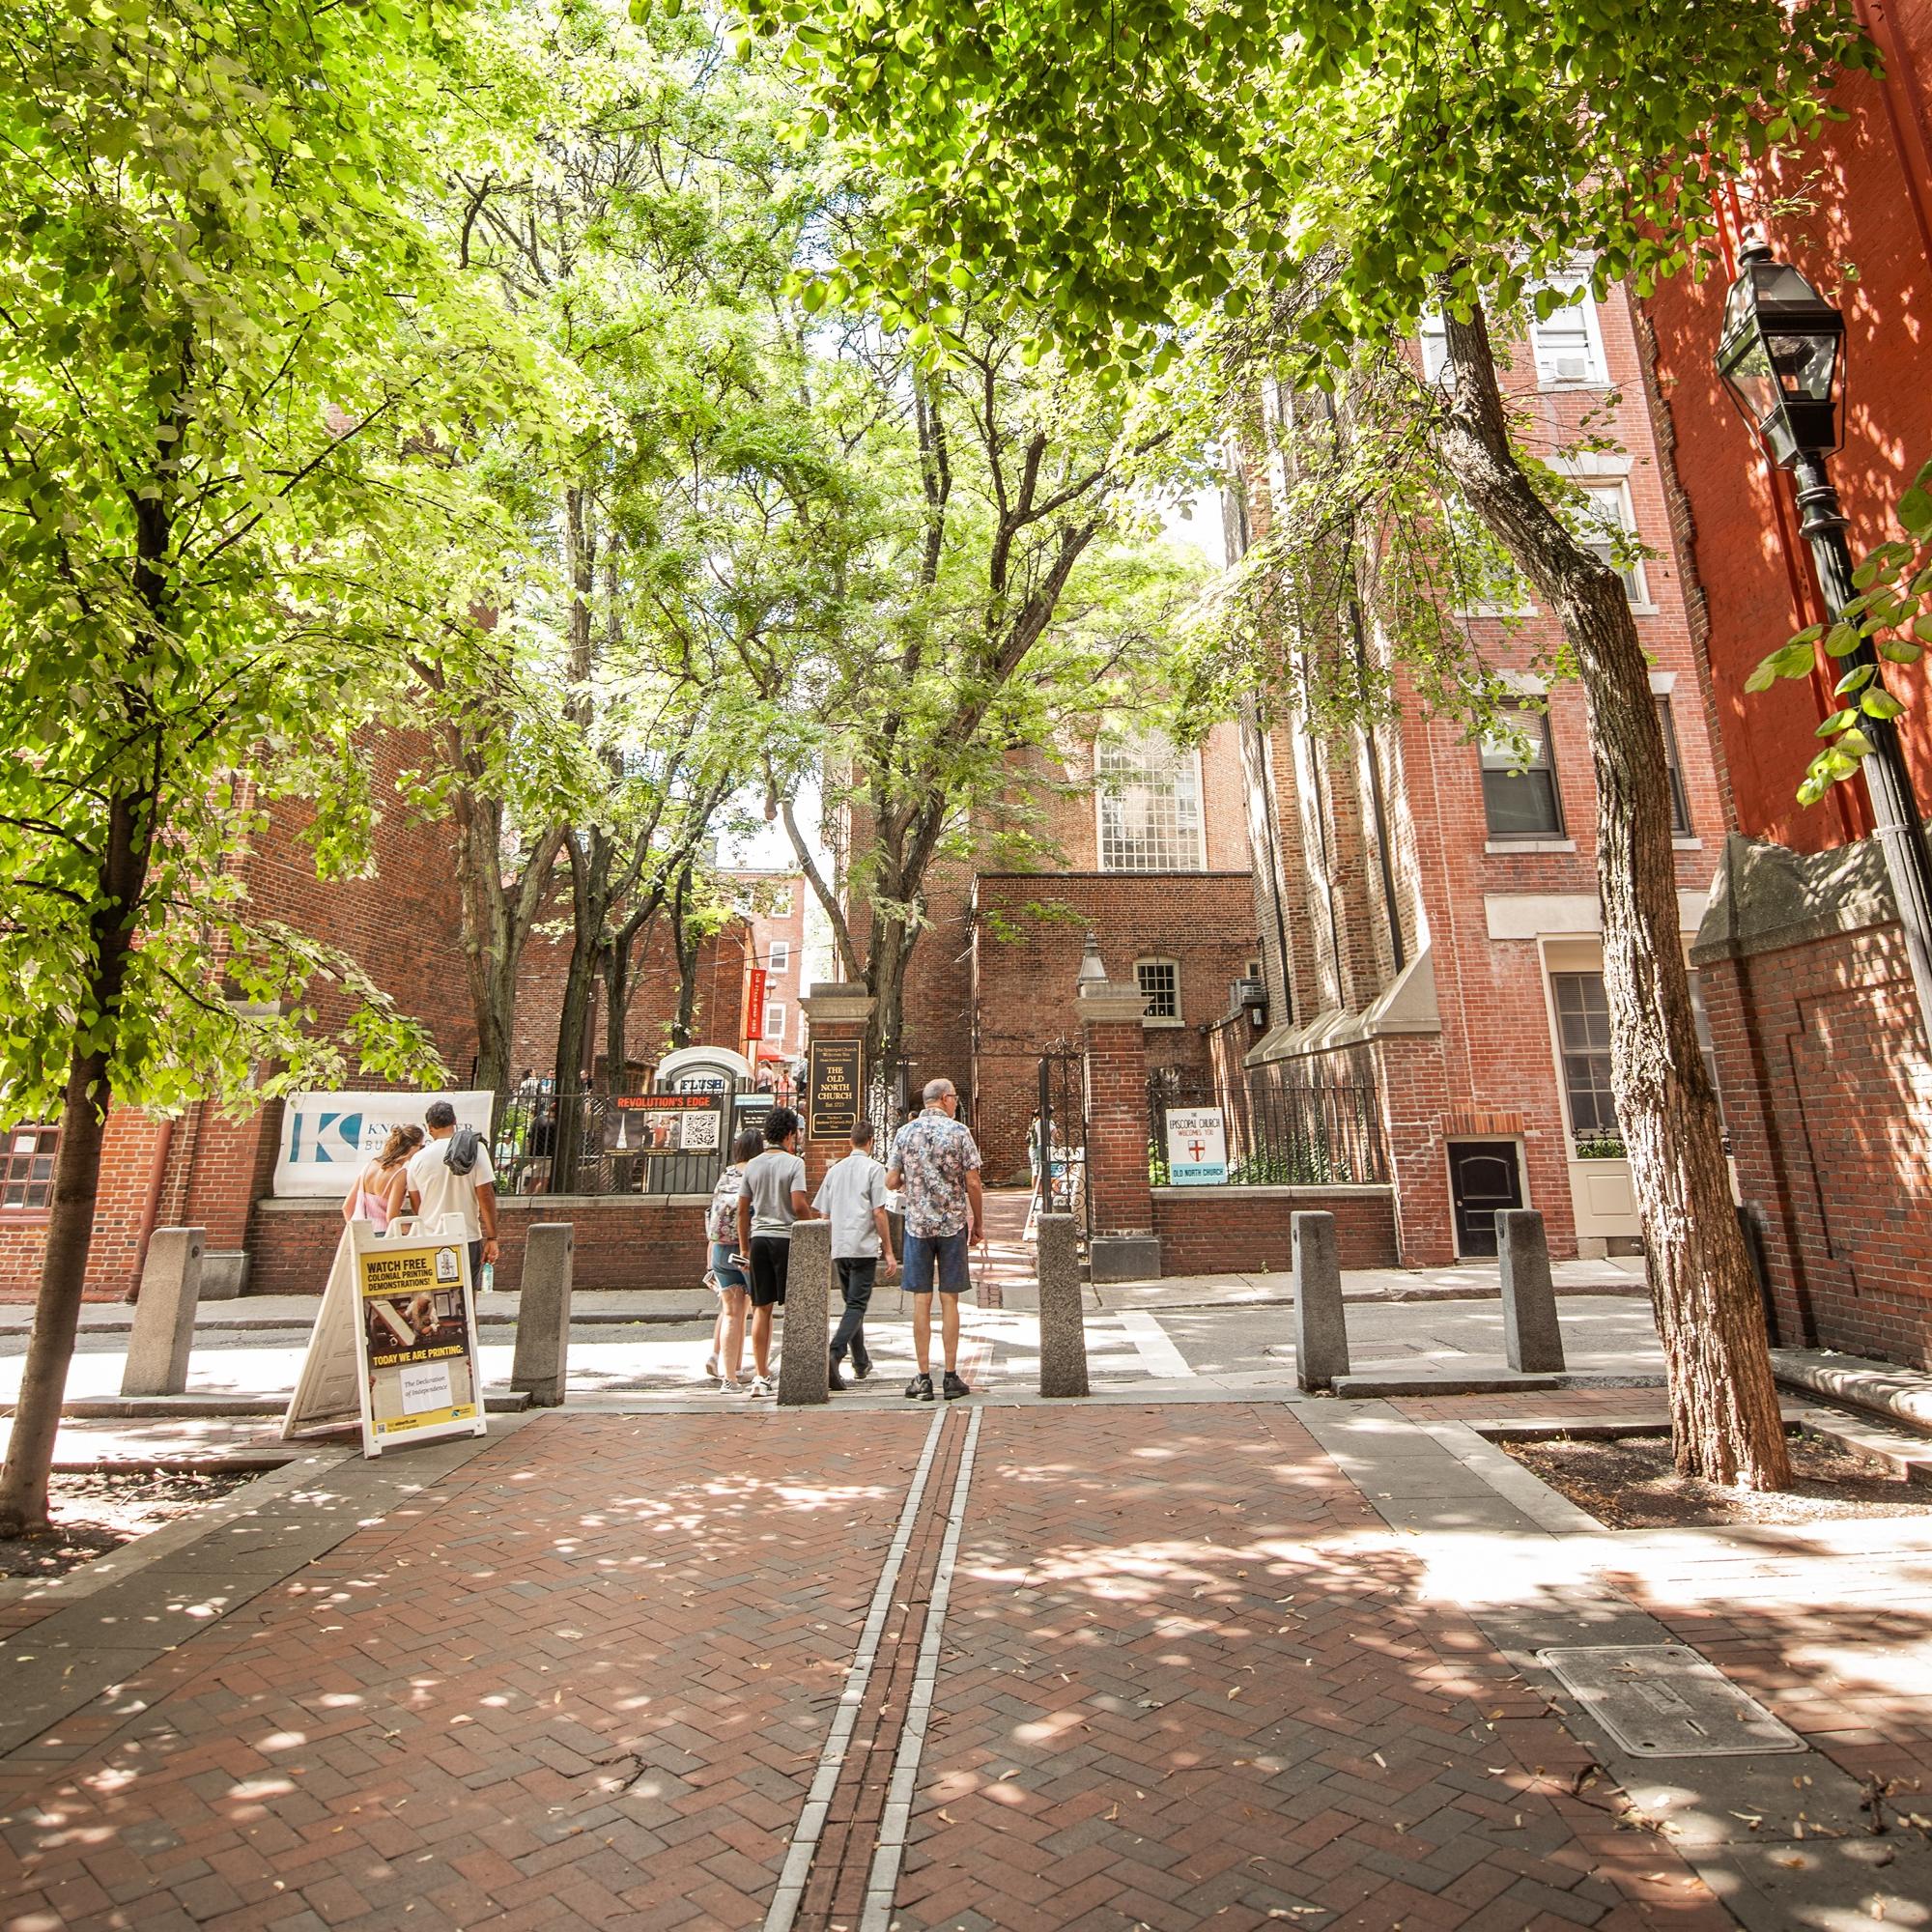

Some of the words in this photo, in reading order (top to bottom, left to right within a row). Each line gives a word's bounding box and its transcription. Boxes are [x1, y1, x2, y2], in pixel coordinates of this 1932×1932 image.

[681, 1079, 723, 1090] FLUSH
[820, 1083, 850, 1092] NORTH
[617, 1097, 684, 1108] REVOLUTION'S
[686, 1096, 710, 1107] EDGE
[817, 1092, 853, 1100] CHURCH
[1170, 1119, 1197, 1129] EPISCOPAL
[1199, 1118, 1220, 1128] CHURCH
[367, 1260, 401, 1273] WATCH
[403, 1258, 427, 1270] FREE
[367, 1272, 401, 1282] COLONIAL
[402, 1268, 433, 1279] PRINTING
[368, 1278, 431, 1292] DEMONSTRATIONS!
[373, 1353, 398, 1366] TODAY
[399, 1352, 412, 1362] WE
[412, 1350, 427, 1361] ARE
[428, 1345, 464, 1358] PRINTING:
